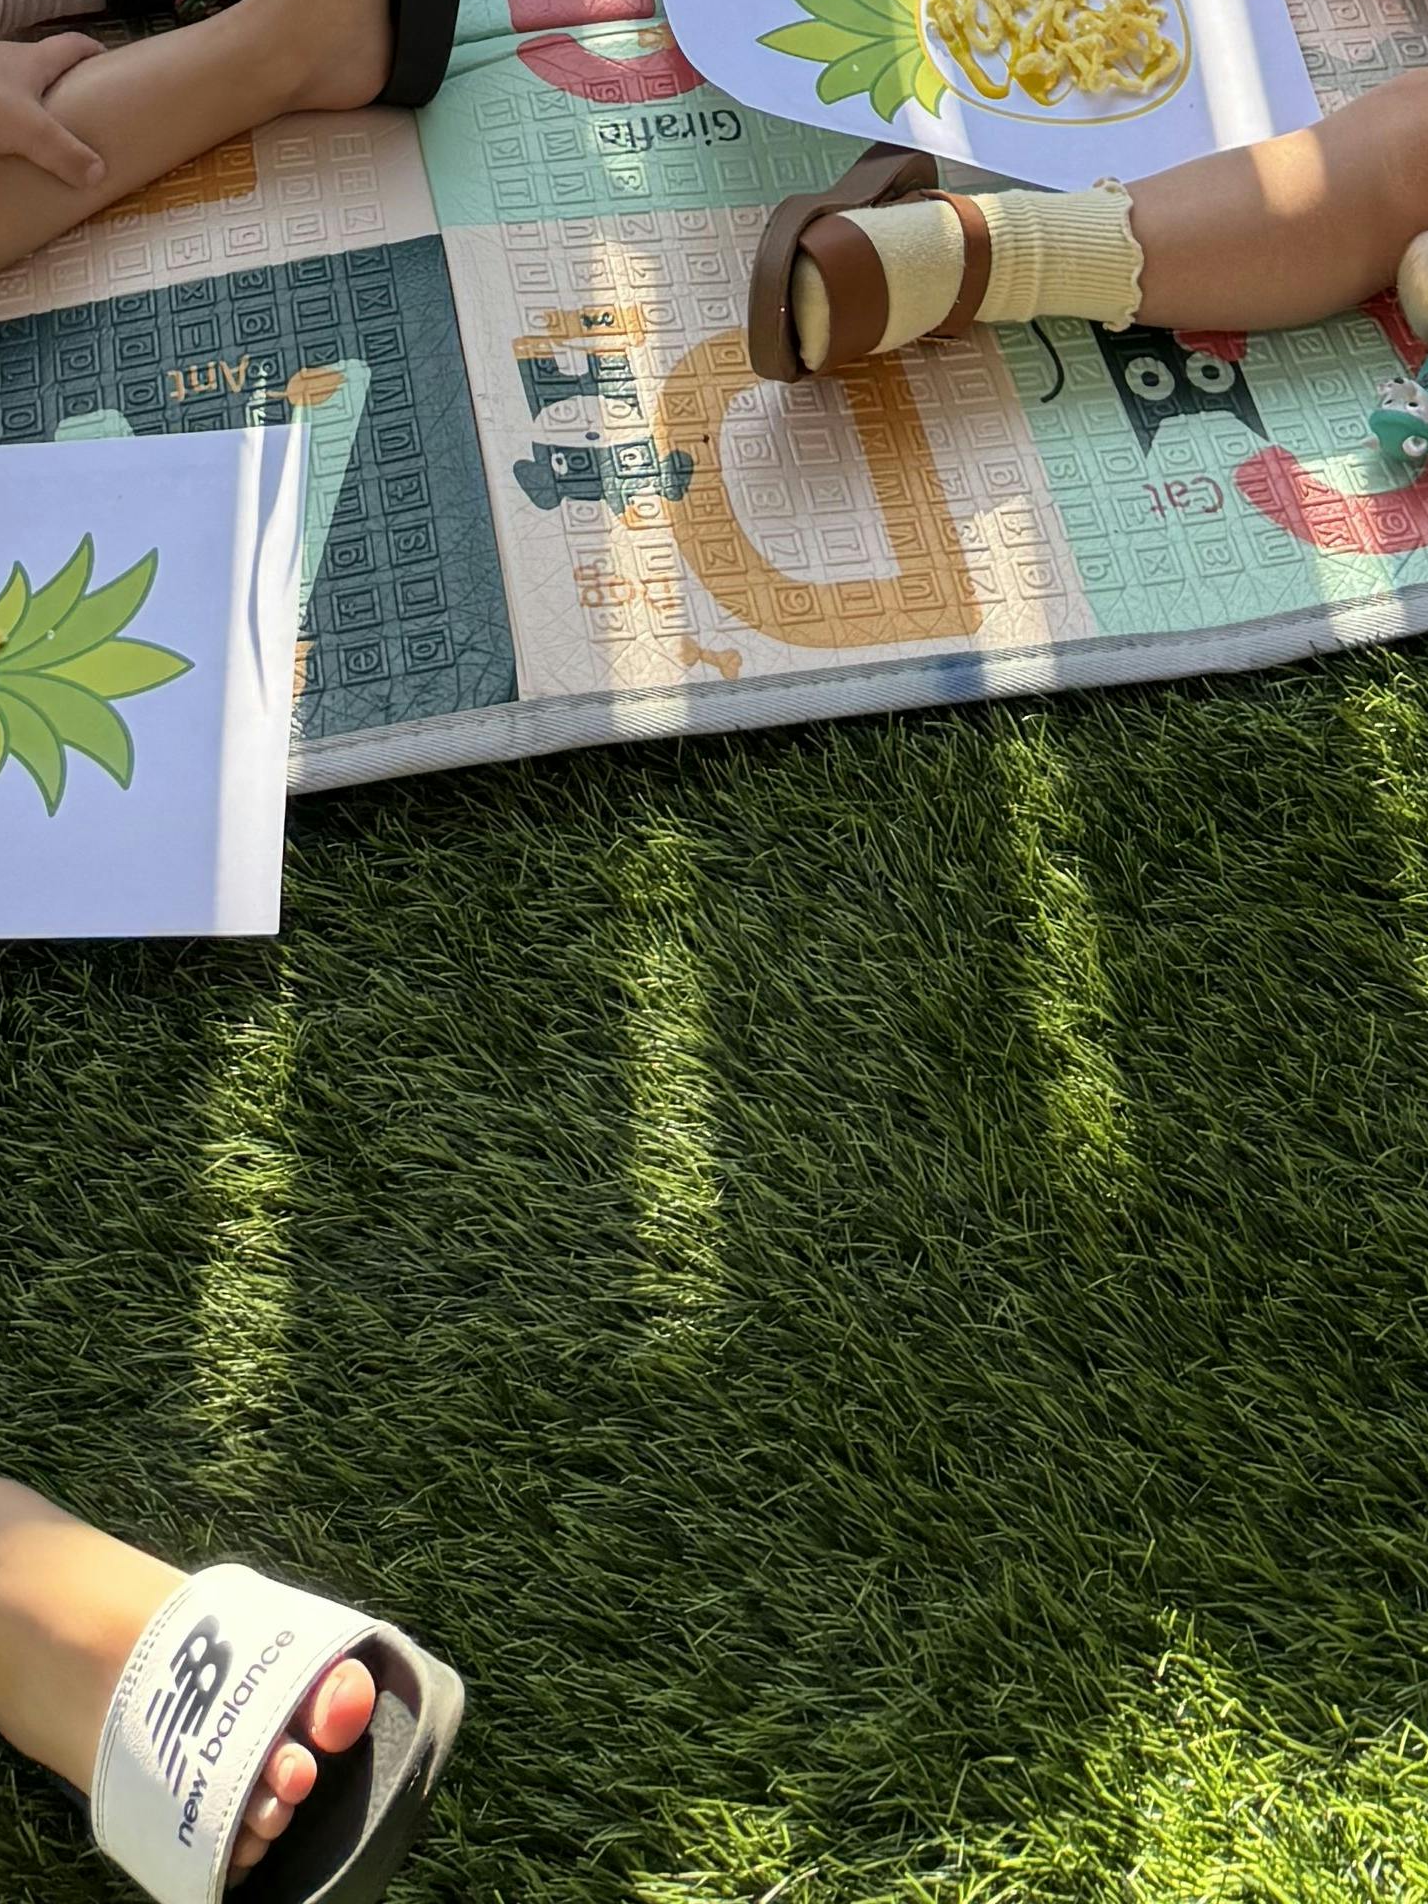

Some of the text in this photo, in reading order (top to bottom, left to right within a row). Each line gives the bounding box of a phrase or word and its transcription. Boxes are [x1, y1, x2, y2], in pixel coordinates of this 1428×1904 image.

[164, 353, 251, 403] Ant
[1143, 476, 1224, 519] Cat
[177, 1629, 296, 1849] new balance
